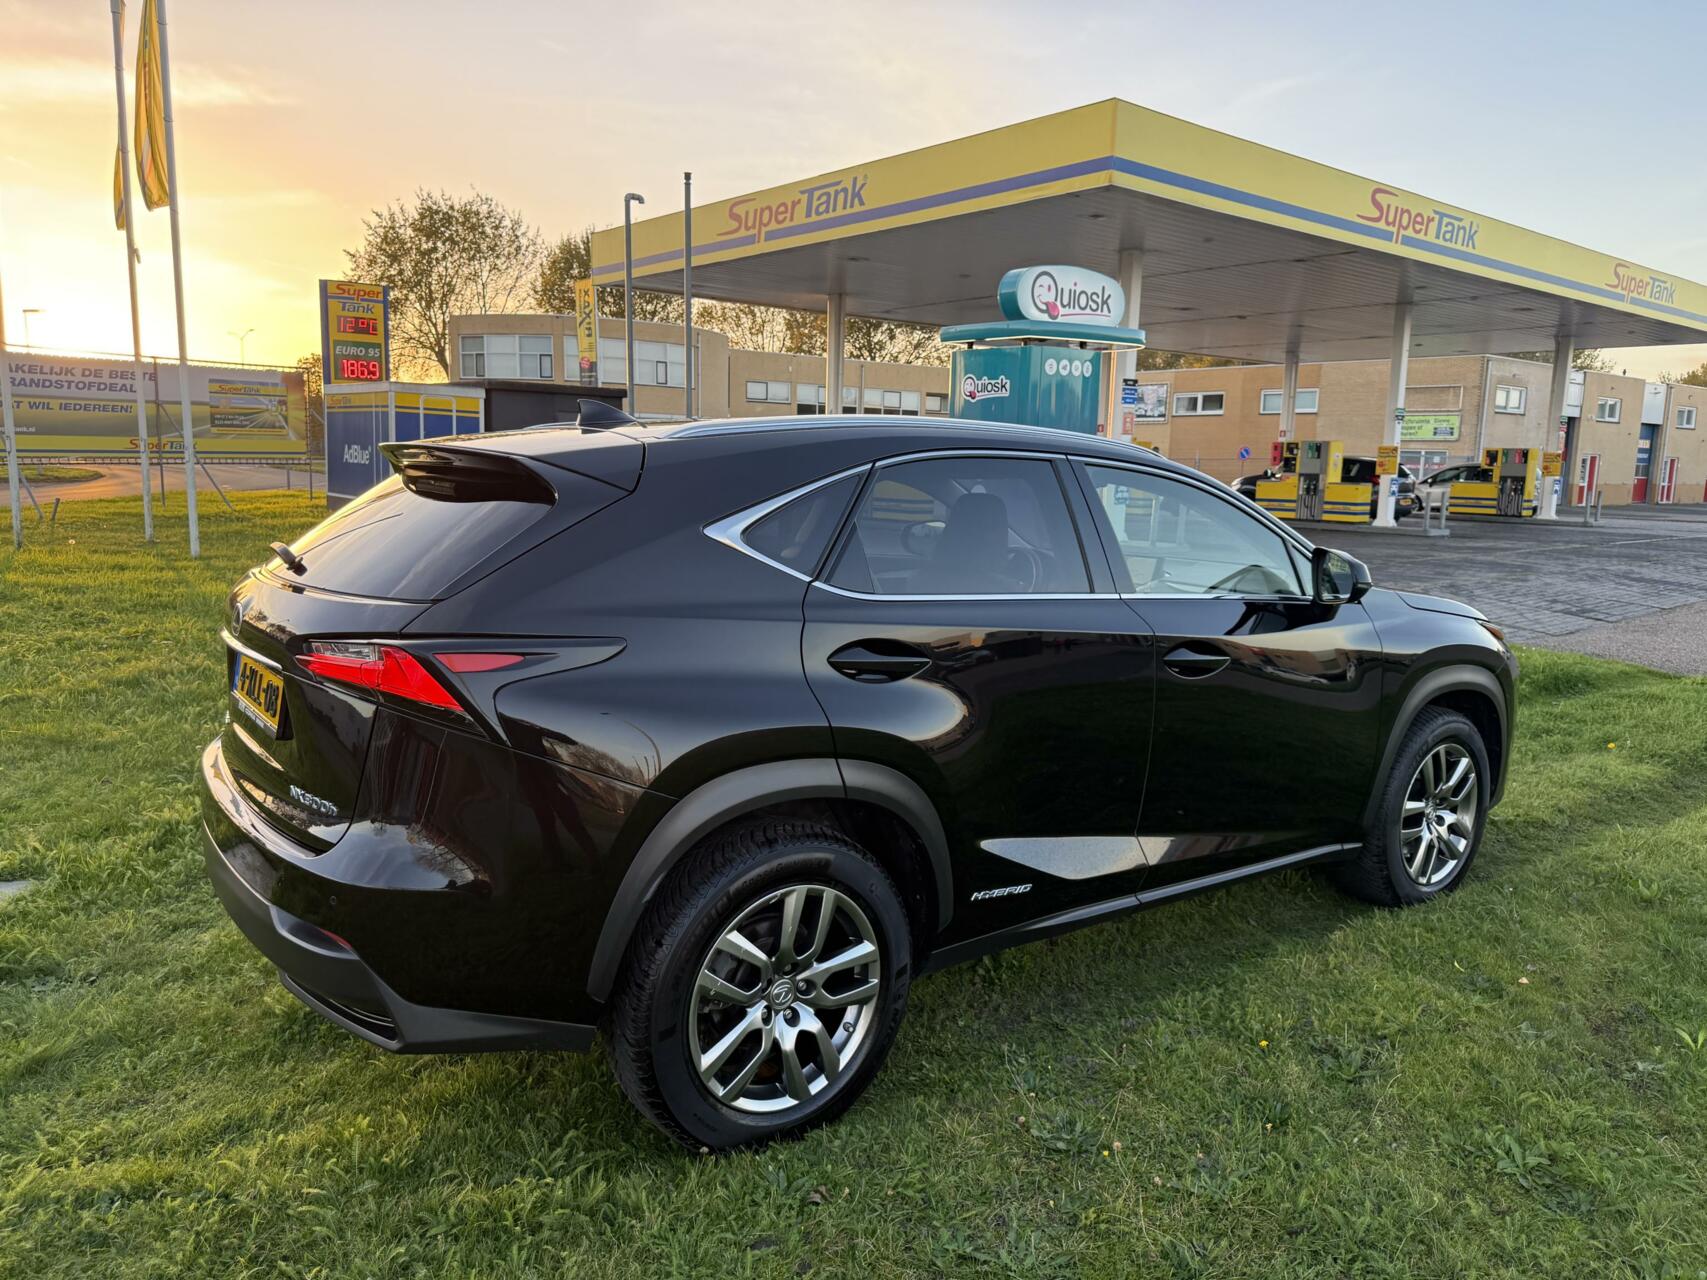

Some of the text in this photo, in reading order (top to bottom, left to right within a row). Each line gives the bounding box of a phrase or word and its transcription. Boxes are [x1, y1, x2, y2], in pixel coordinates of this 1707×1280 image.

[335, 283, 382, 302] Super
[1031, 270, 1112, 320] Quiosk
[338, 302, 374, 314] Tank
[335, 345, 380, 357] EURO 95
[81, 367, 104, 378] DE
[963, 375, 1008, 399] Quiosk
[28, 401, 54, 411] WIL
[59, 402, 133, 414] IEDEREEN!
[343, 444, 371, 465] AdBlue
[970, 883, 1033, 901] HYBRID
